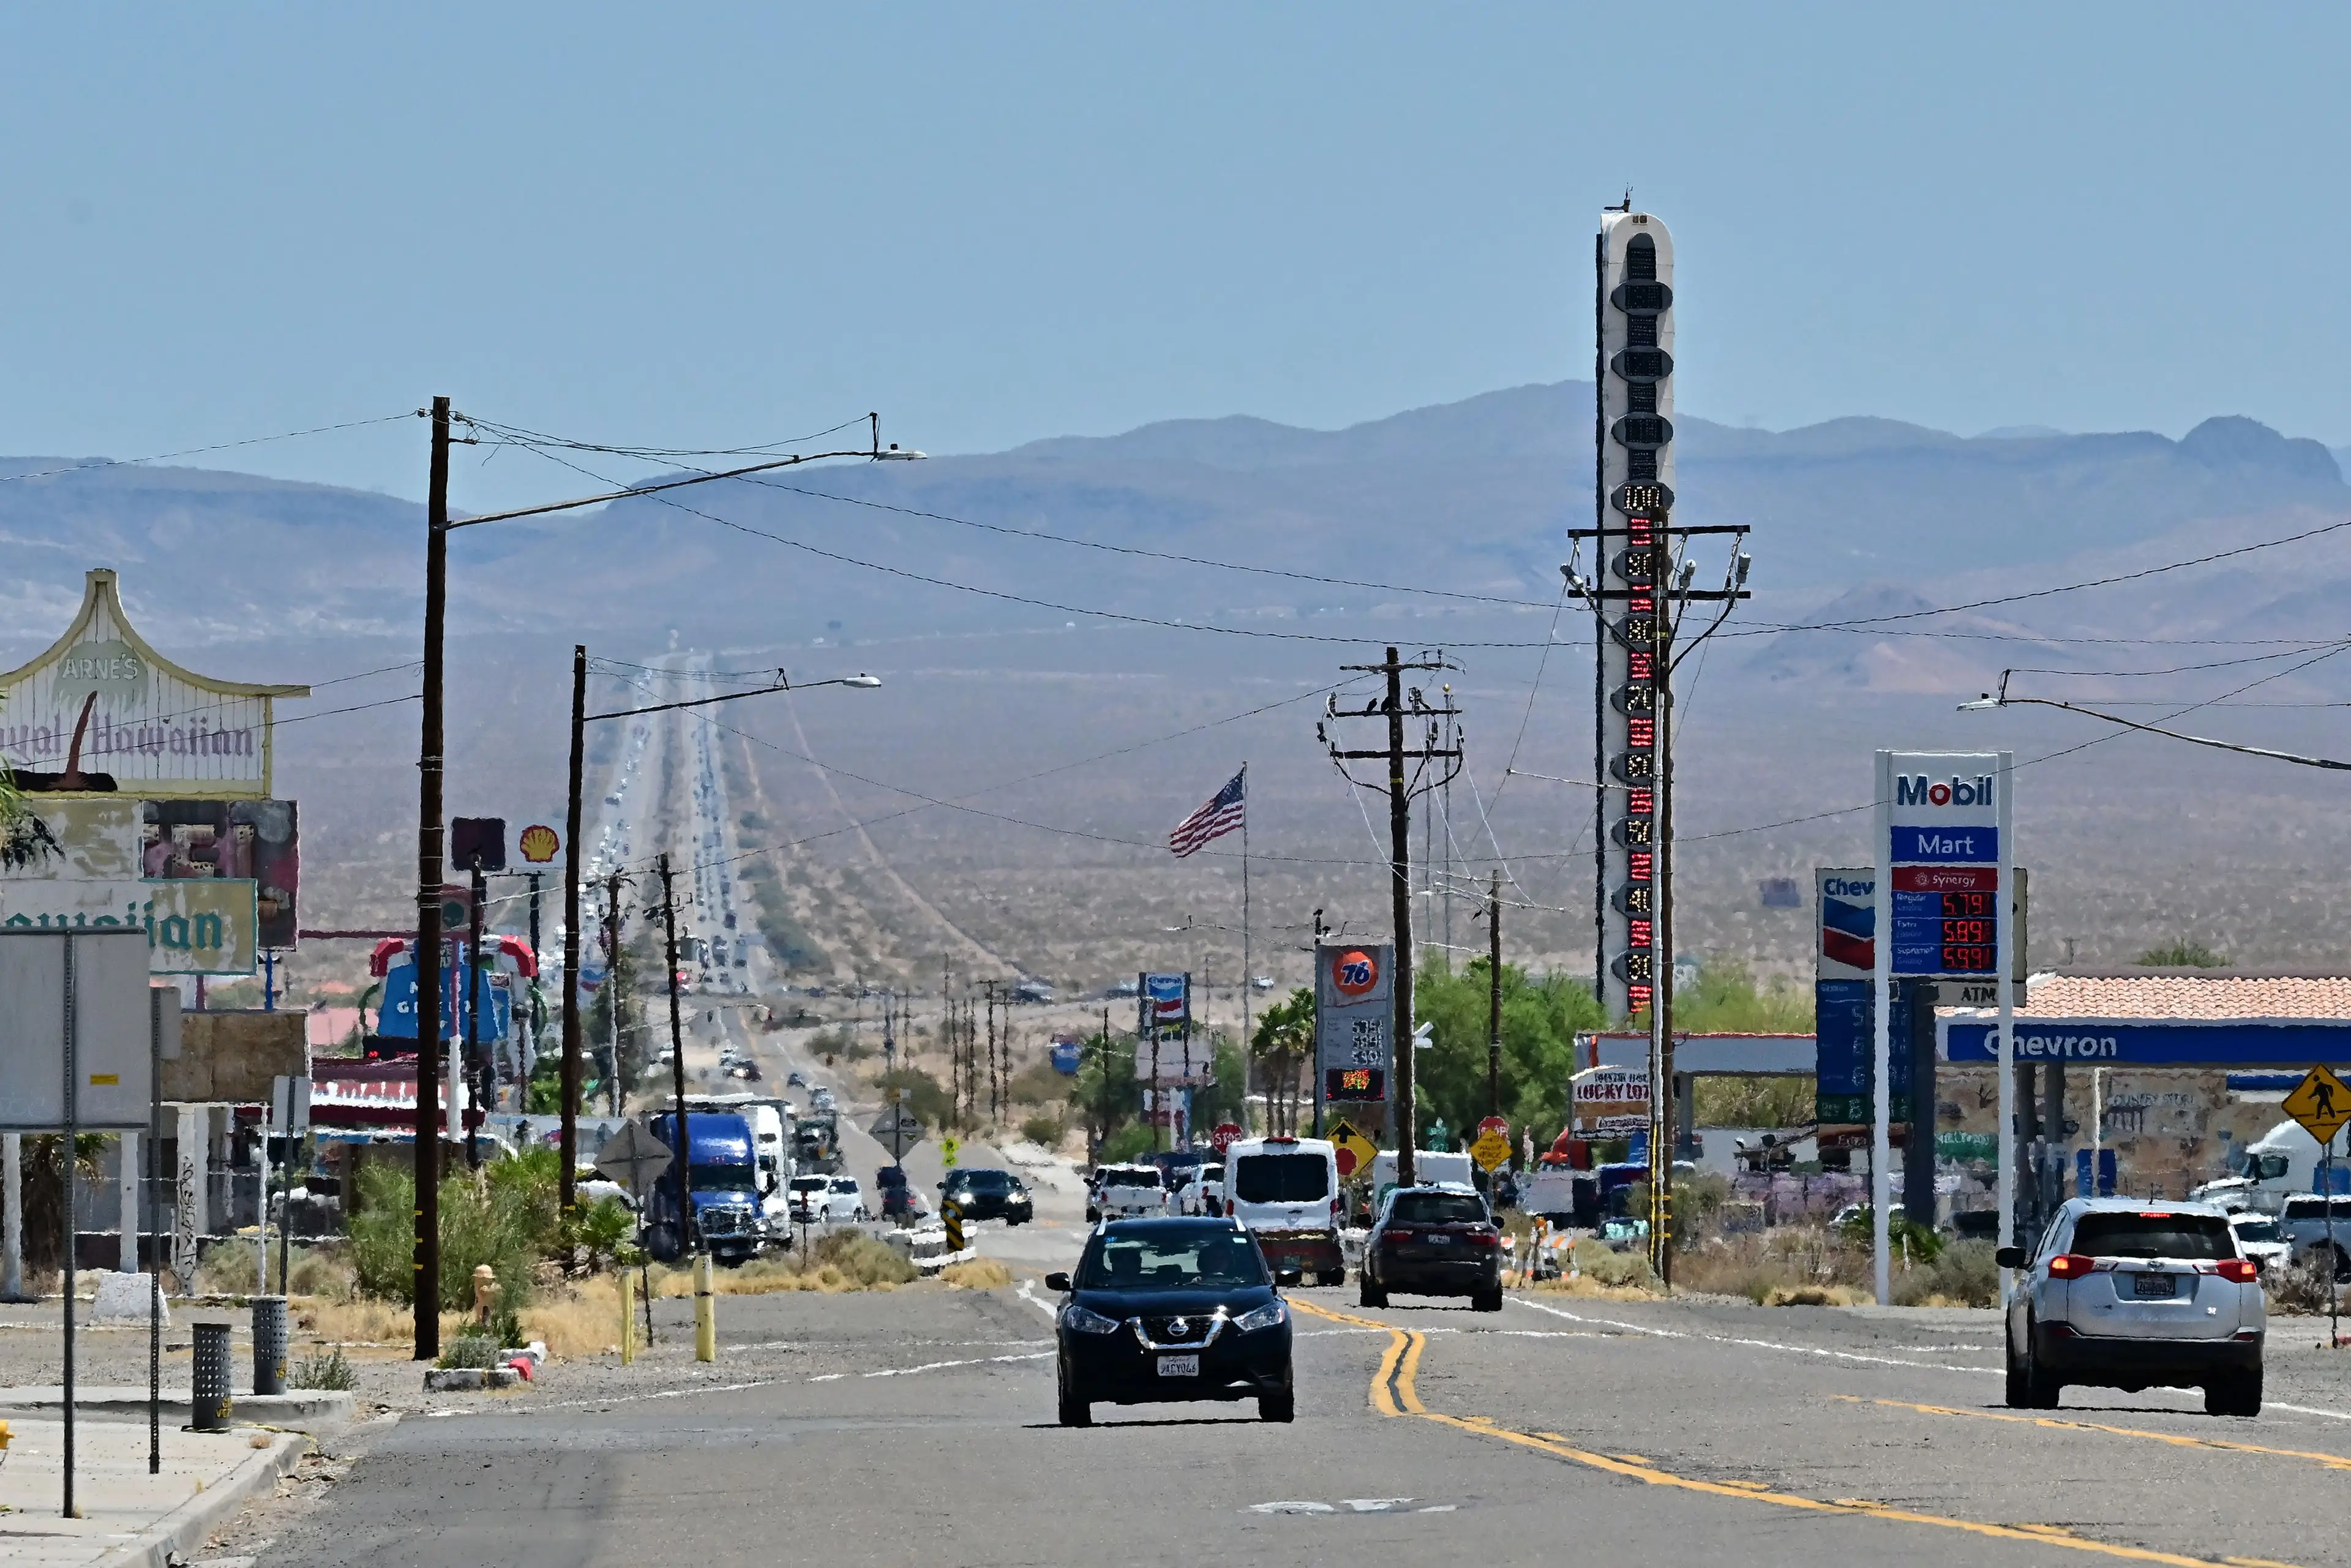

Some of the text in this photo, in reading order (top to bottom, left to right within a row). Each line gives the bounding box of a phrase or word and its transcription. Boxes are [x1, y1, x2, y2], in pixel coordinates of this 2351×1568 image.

[62, 654, 138, 681] ARNE'S
[91, 711, 253, 758] Hawaiian
[1897, 775, 1992, 806] Mobil
[1918, 835, 1975, 855] Mart
[1932, 875, 1976, 888] Synergy
[1339, 959, 1370, 986] 76
[1961, 987, 1996, 1002] ATM
[1215, 1130, 1242, 1145] STOP
